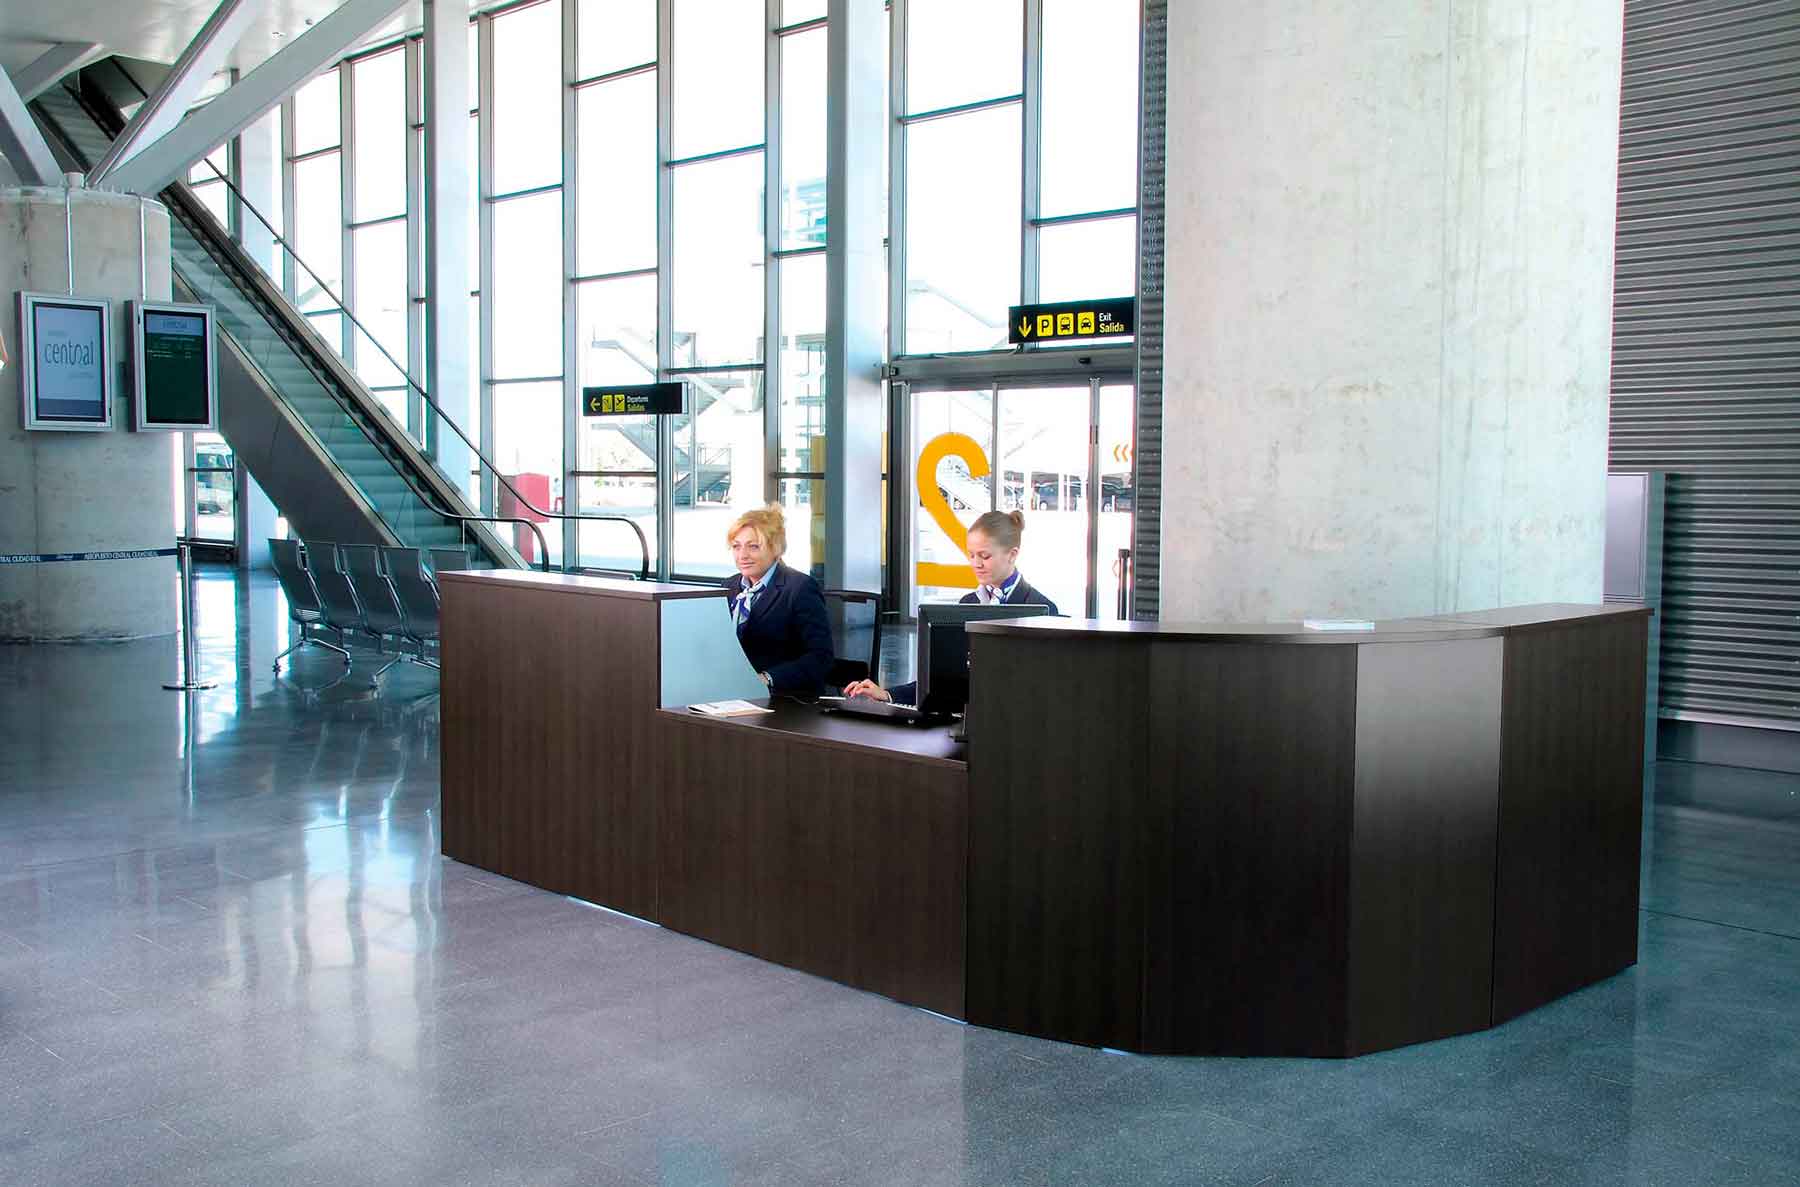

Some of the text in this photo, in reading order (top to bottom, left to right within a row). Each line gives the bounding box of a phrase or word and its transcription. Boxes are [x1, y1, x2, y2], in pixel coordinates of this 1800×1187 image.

[1099, 312, 1112, 322] Exit
[1041, 319, 1050, 333] P
[1099, 322, 1125, 334] Salida
[917, 432, 991, 589] 2
